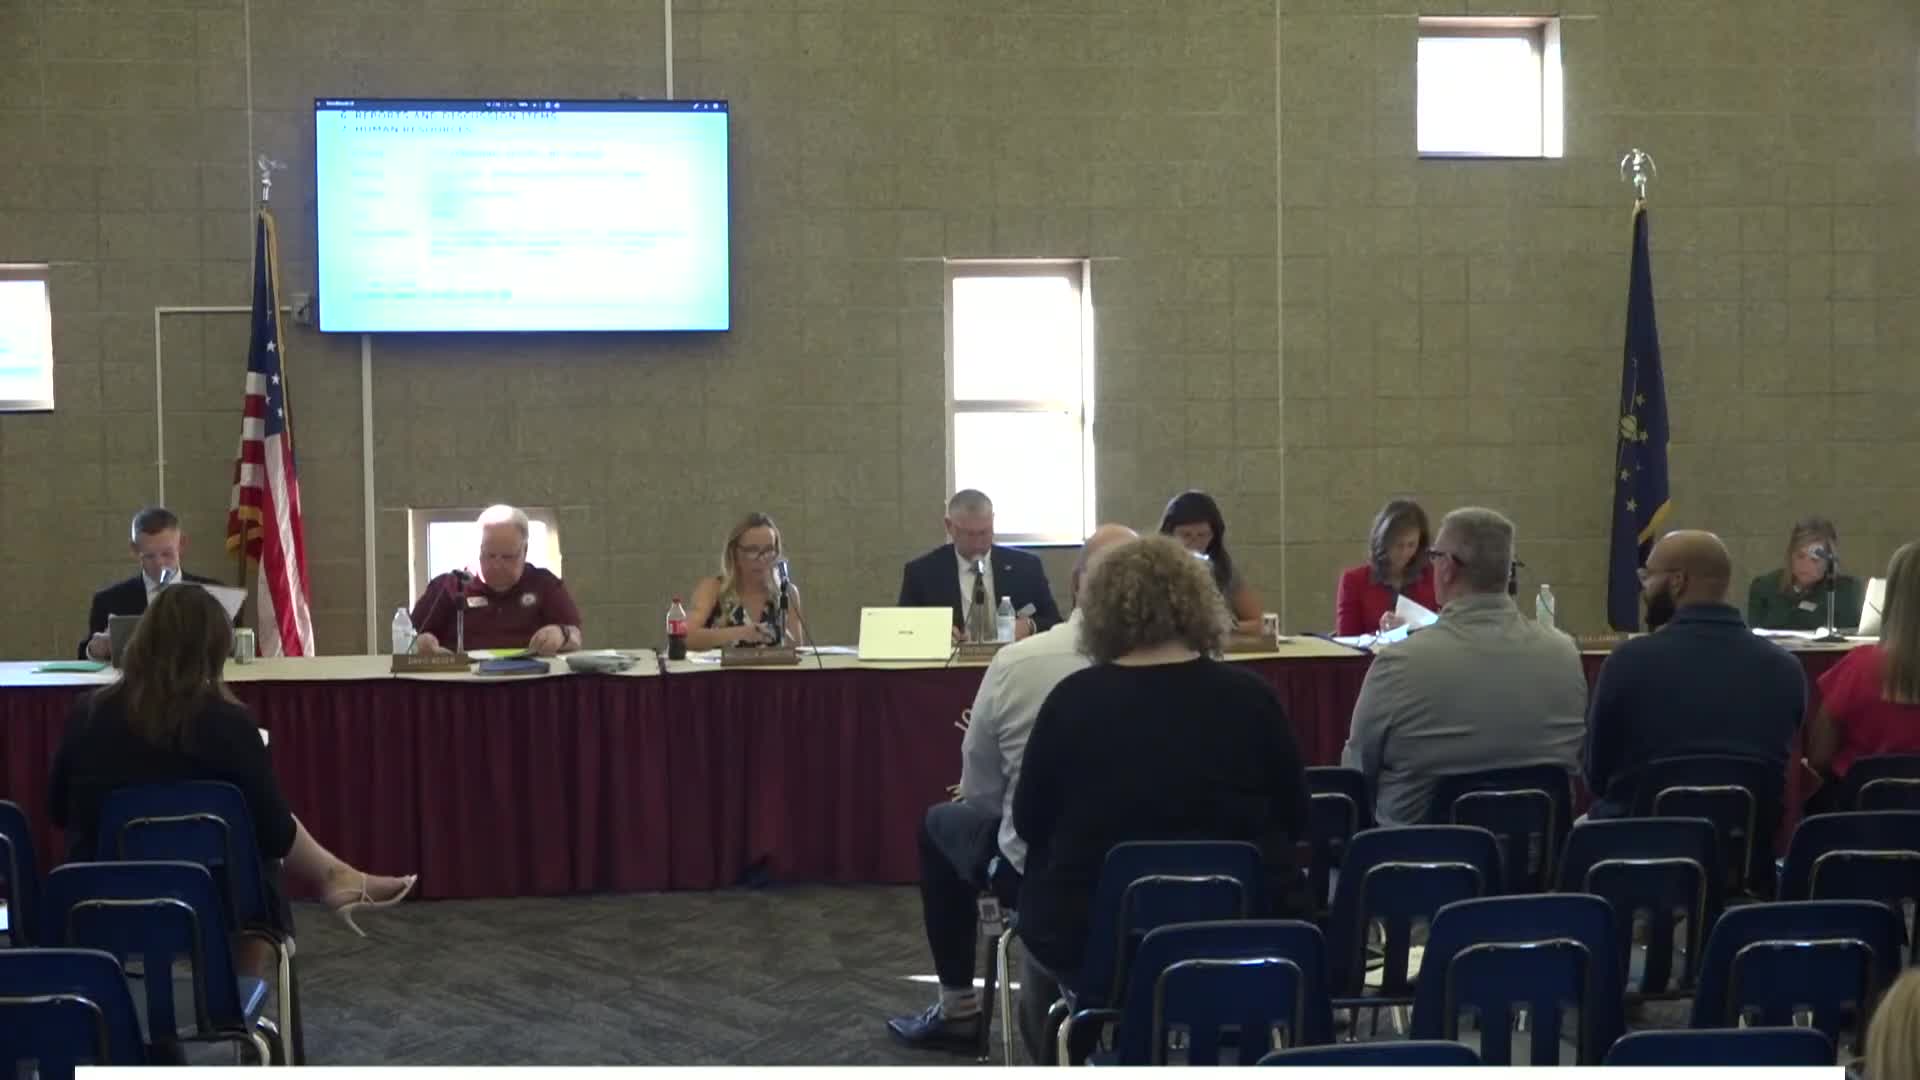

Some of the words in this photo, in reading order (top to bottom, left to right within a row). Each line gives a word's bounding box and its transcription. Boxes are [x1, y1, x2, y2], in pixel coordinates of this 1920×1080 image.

[355, 111, 409, 119] REPORTS
[415, 111, 437, 119] AND
[443, 111, 516, 120] DISCUSSION
[522, 111, 557, 120] ITEMS
[355, 125, 399, 133] HUMAN
[403, 125, 473, 133] RESOURCES
